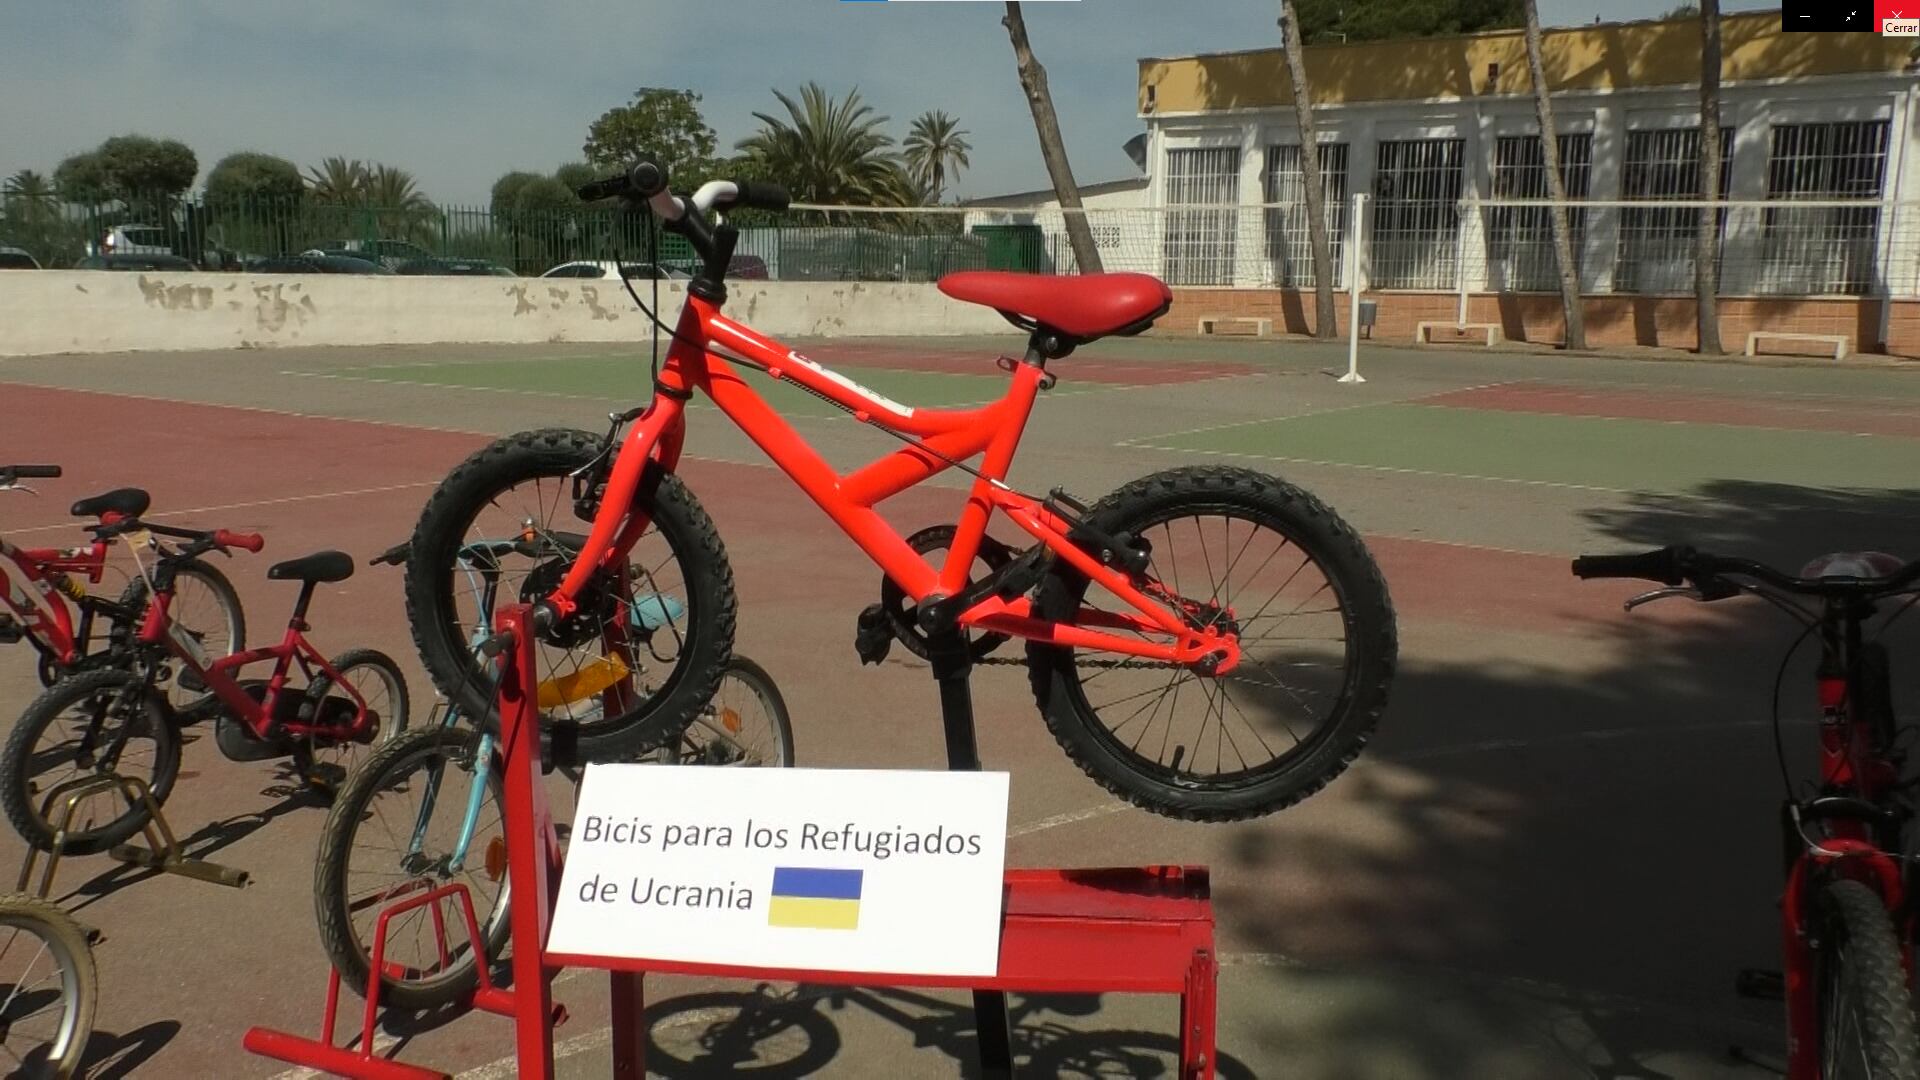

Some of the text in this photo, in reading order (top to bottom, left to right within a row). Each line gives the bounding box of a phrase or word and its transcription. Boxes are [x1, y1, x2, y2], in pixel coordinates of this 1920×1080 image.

[583, 816, 982, 860] Bicis para los Refugiados
[579, 874, 753, 910] de Ucrania
